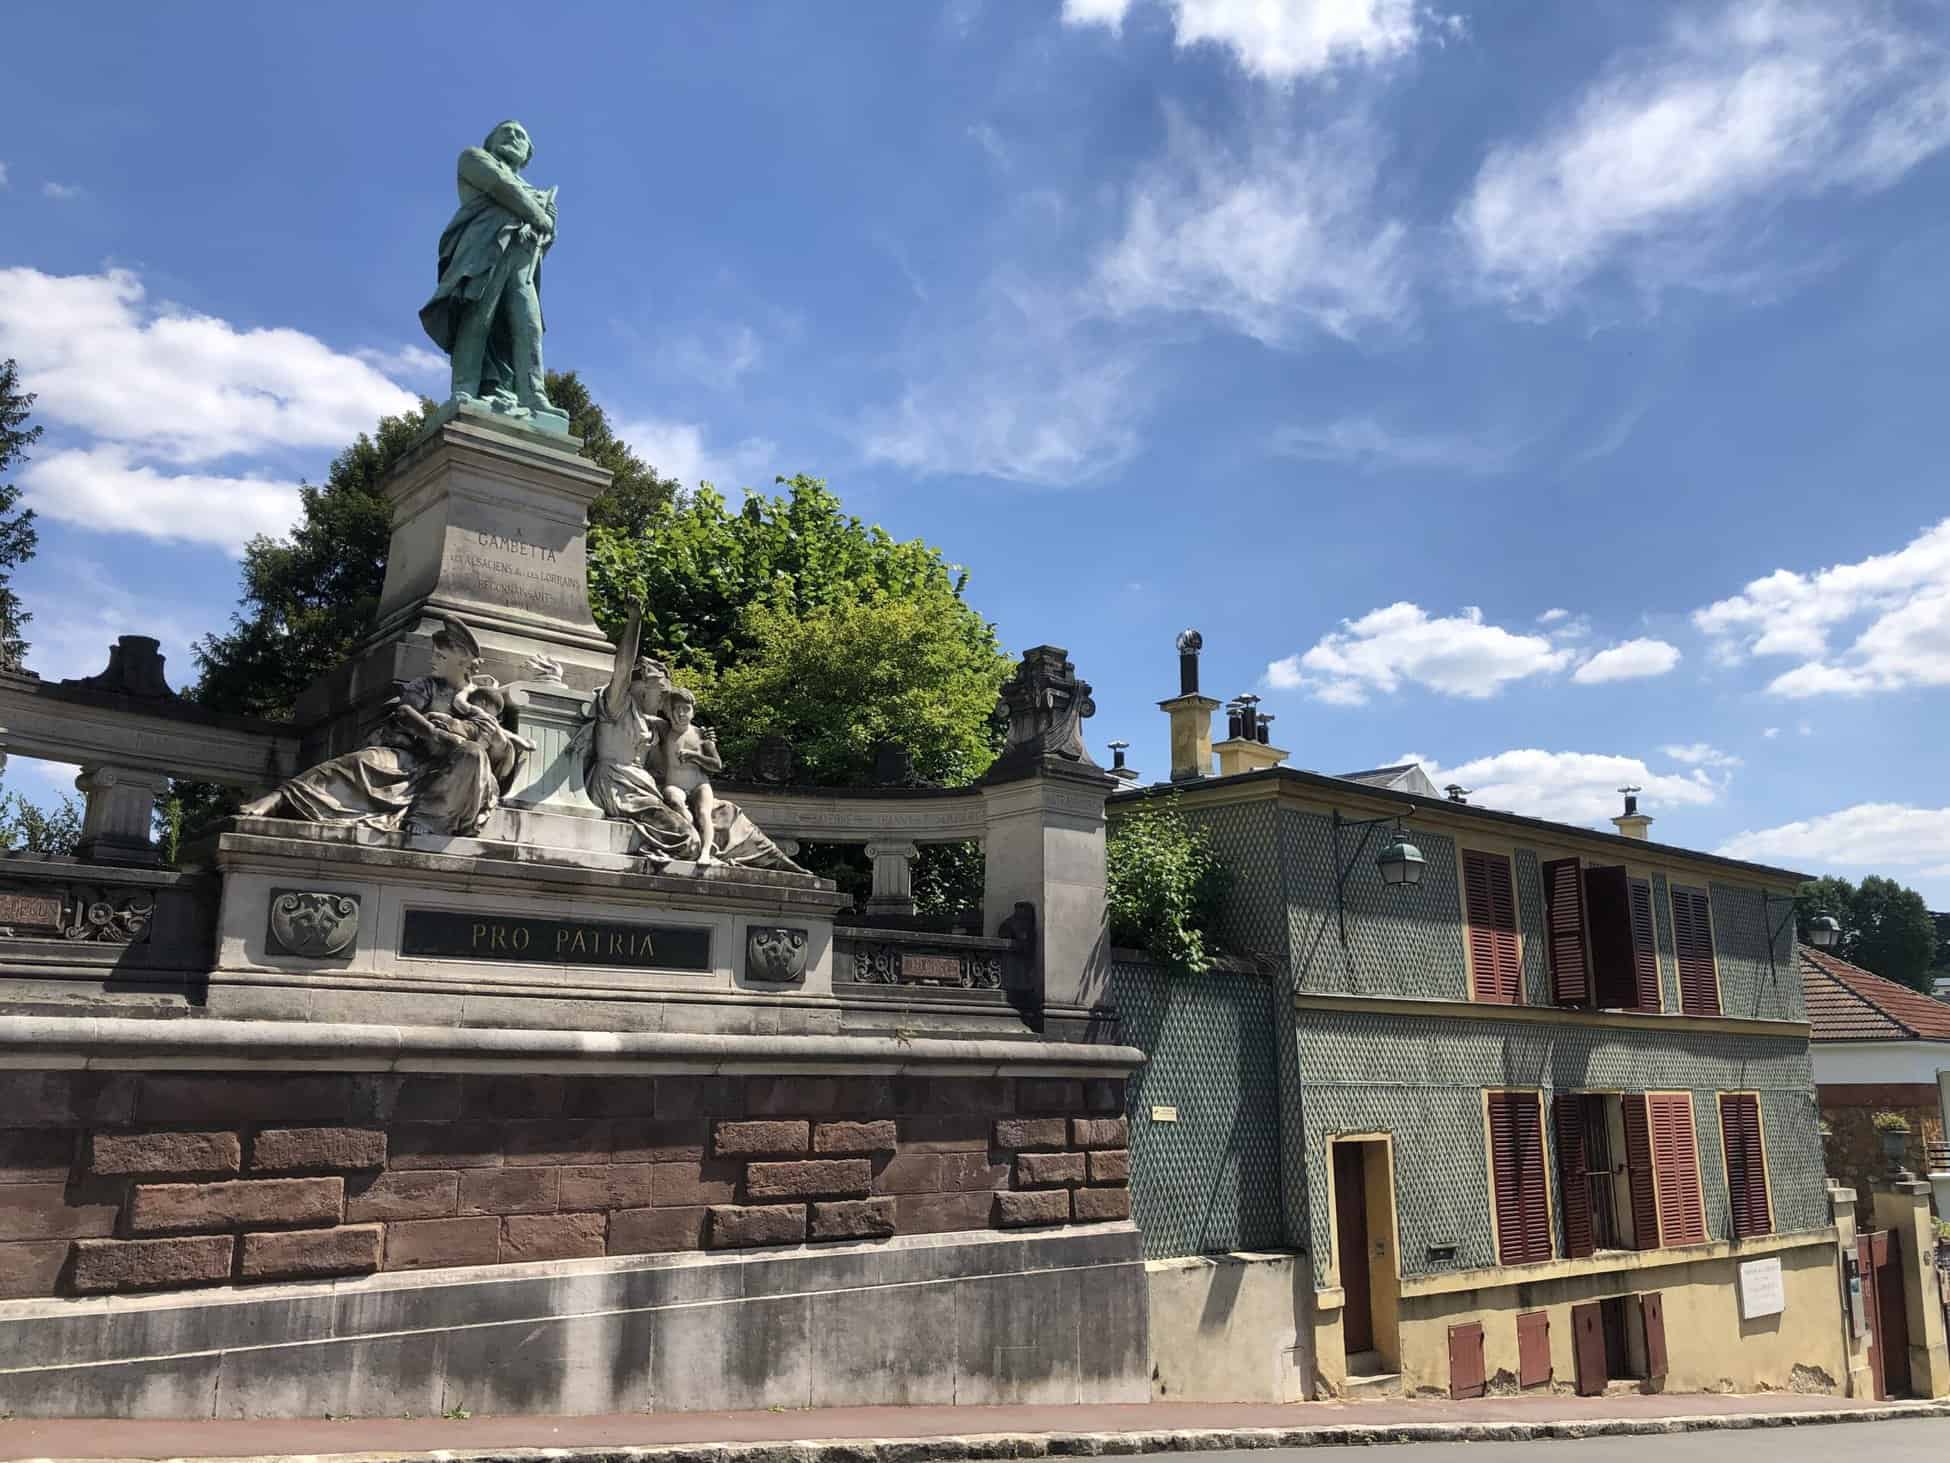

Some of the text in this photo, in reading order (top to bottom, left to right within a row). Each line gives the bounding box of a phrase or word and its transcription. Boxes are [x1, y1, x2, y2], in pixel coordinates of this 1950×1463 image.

[478, 532, 556, 563] GAMBETTA
[471, 923, 656, 957] PRO PATRIA
